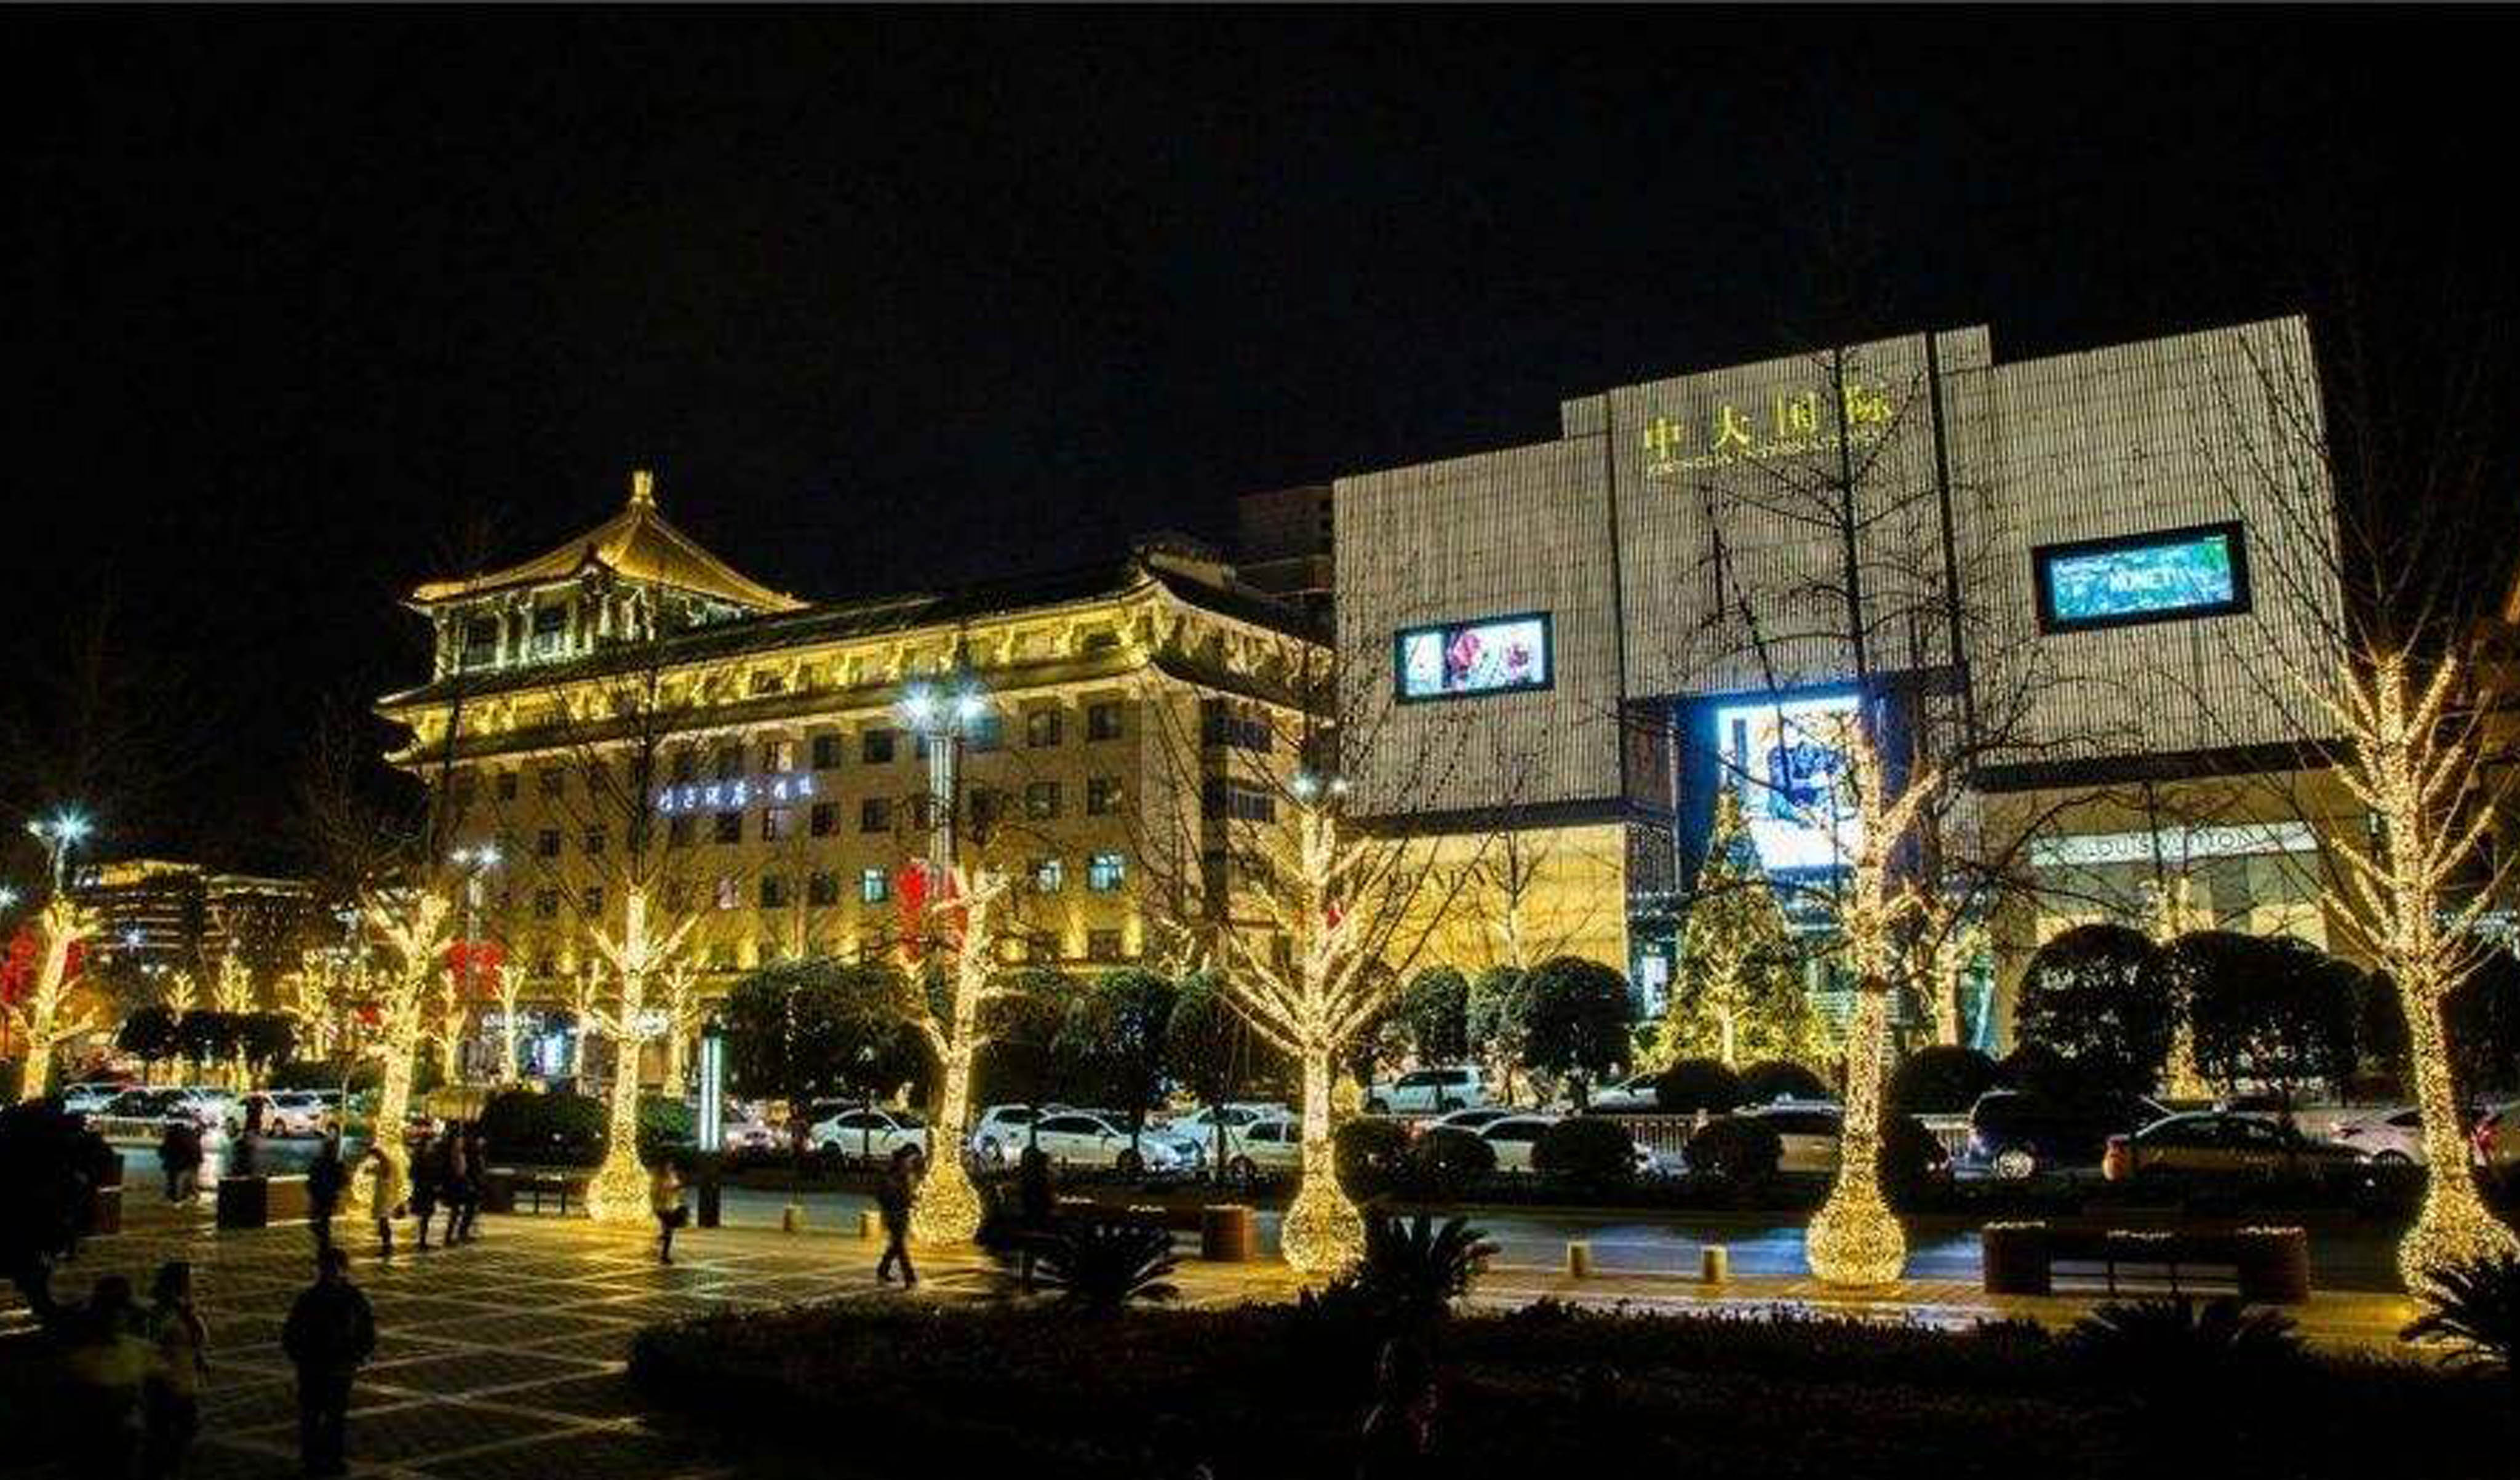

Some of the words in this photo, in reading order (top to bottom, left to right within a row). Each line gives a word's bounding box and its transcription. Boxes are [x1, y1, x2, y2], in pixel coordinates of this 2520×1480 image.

[1644, 382, 1893, 458] 中大国际
[2155, 830, 2254, 853] VUTTON
